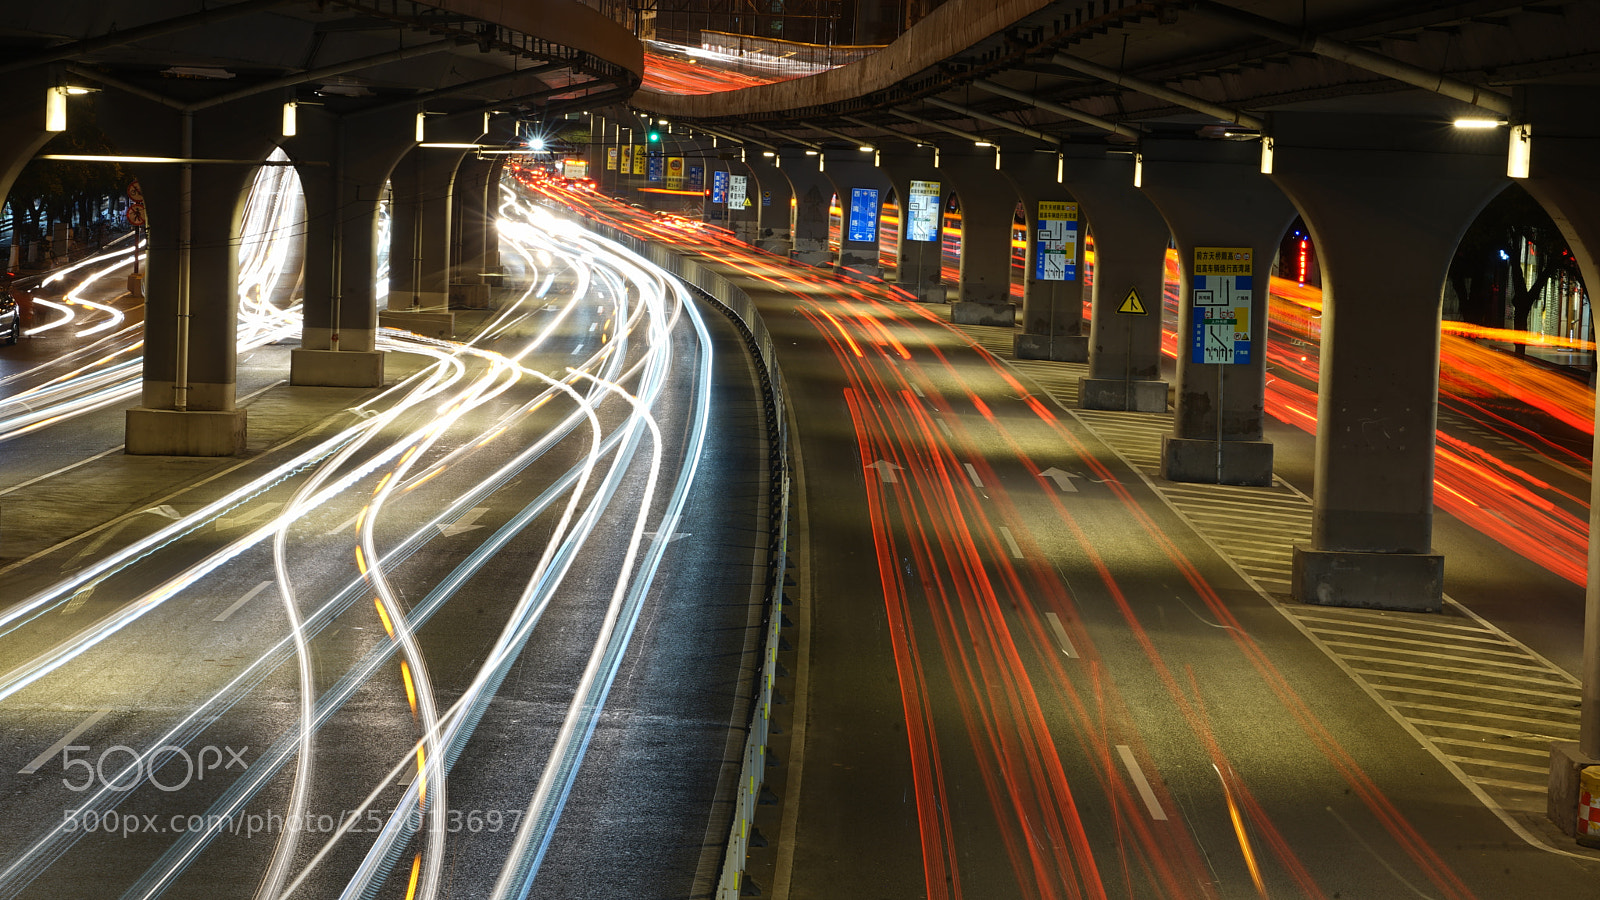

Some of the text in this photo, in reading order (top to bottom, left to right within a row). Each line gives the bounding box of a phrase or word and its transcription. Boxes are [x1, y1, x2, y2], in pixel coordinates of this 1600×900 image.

[1196, 251, 1233, 260] 前方天桥限高
